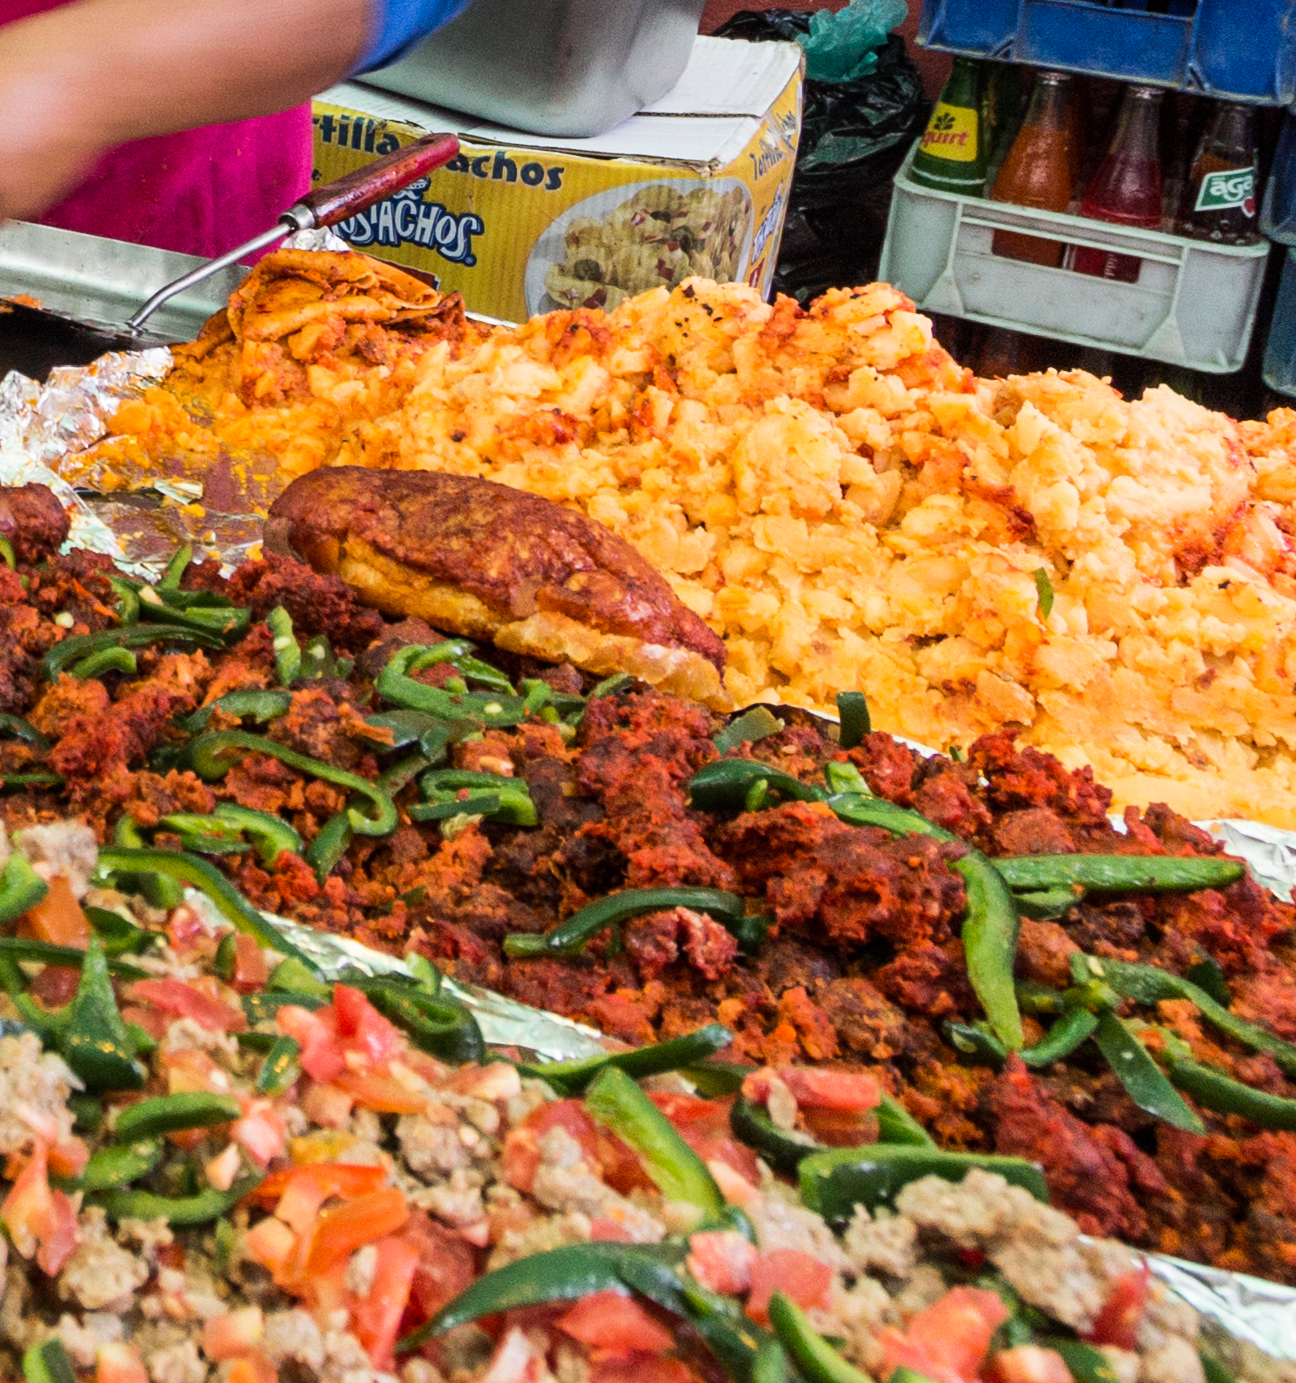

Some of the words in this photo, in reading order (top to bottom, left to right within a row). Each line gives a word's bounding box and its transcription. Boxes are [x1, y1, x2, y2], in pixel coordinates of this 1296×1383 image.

[312, 114, 400, 156] tilla
[445, 151, 565, 191] achos
[920, 130, 970, 148] quirt
